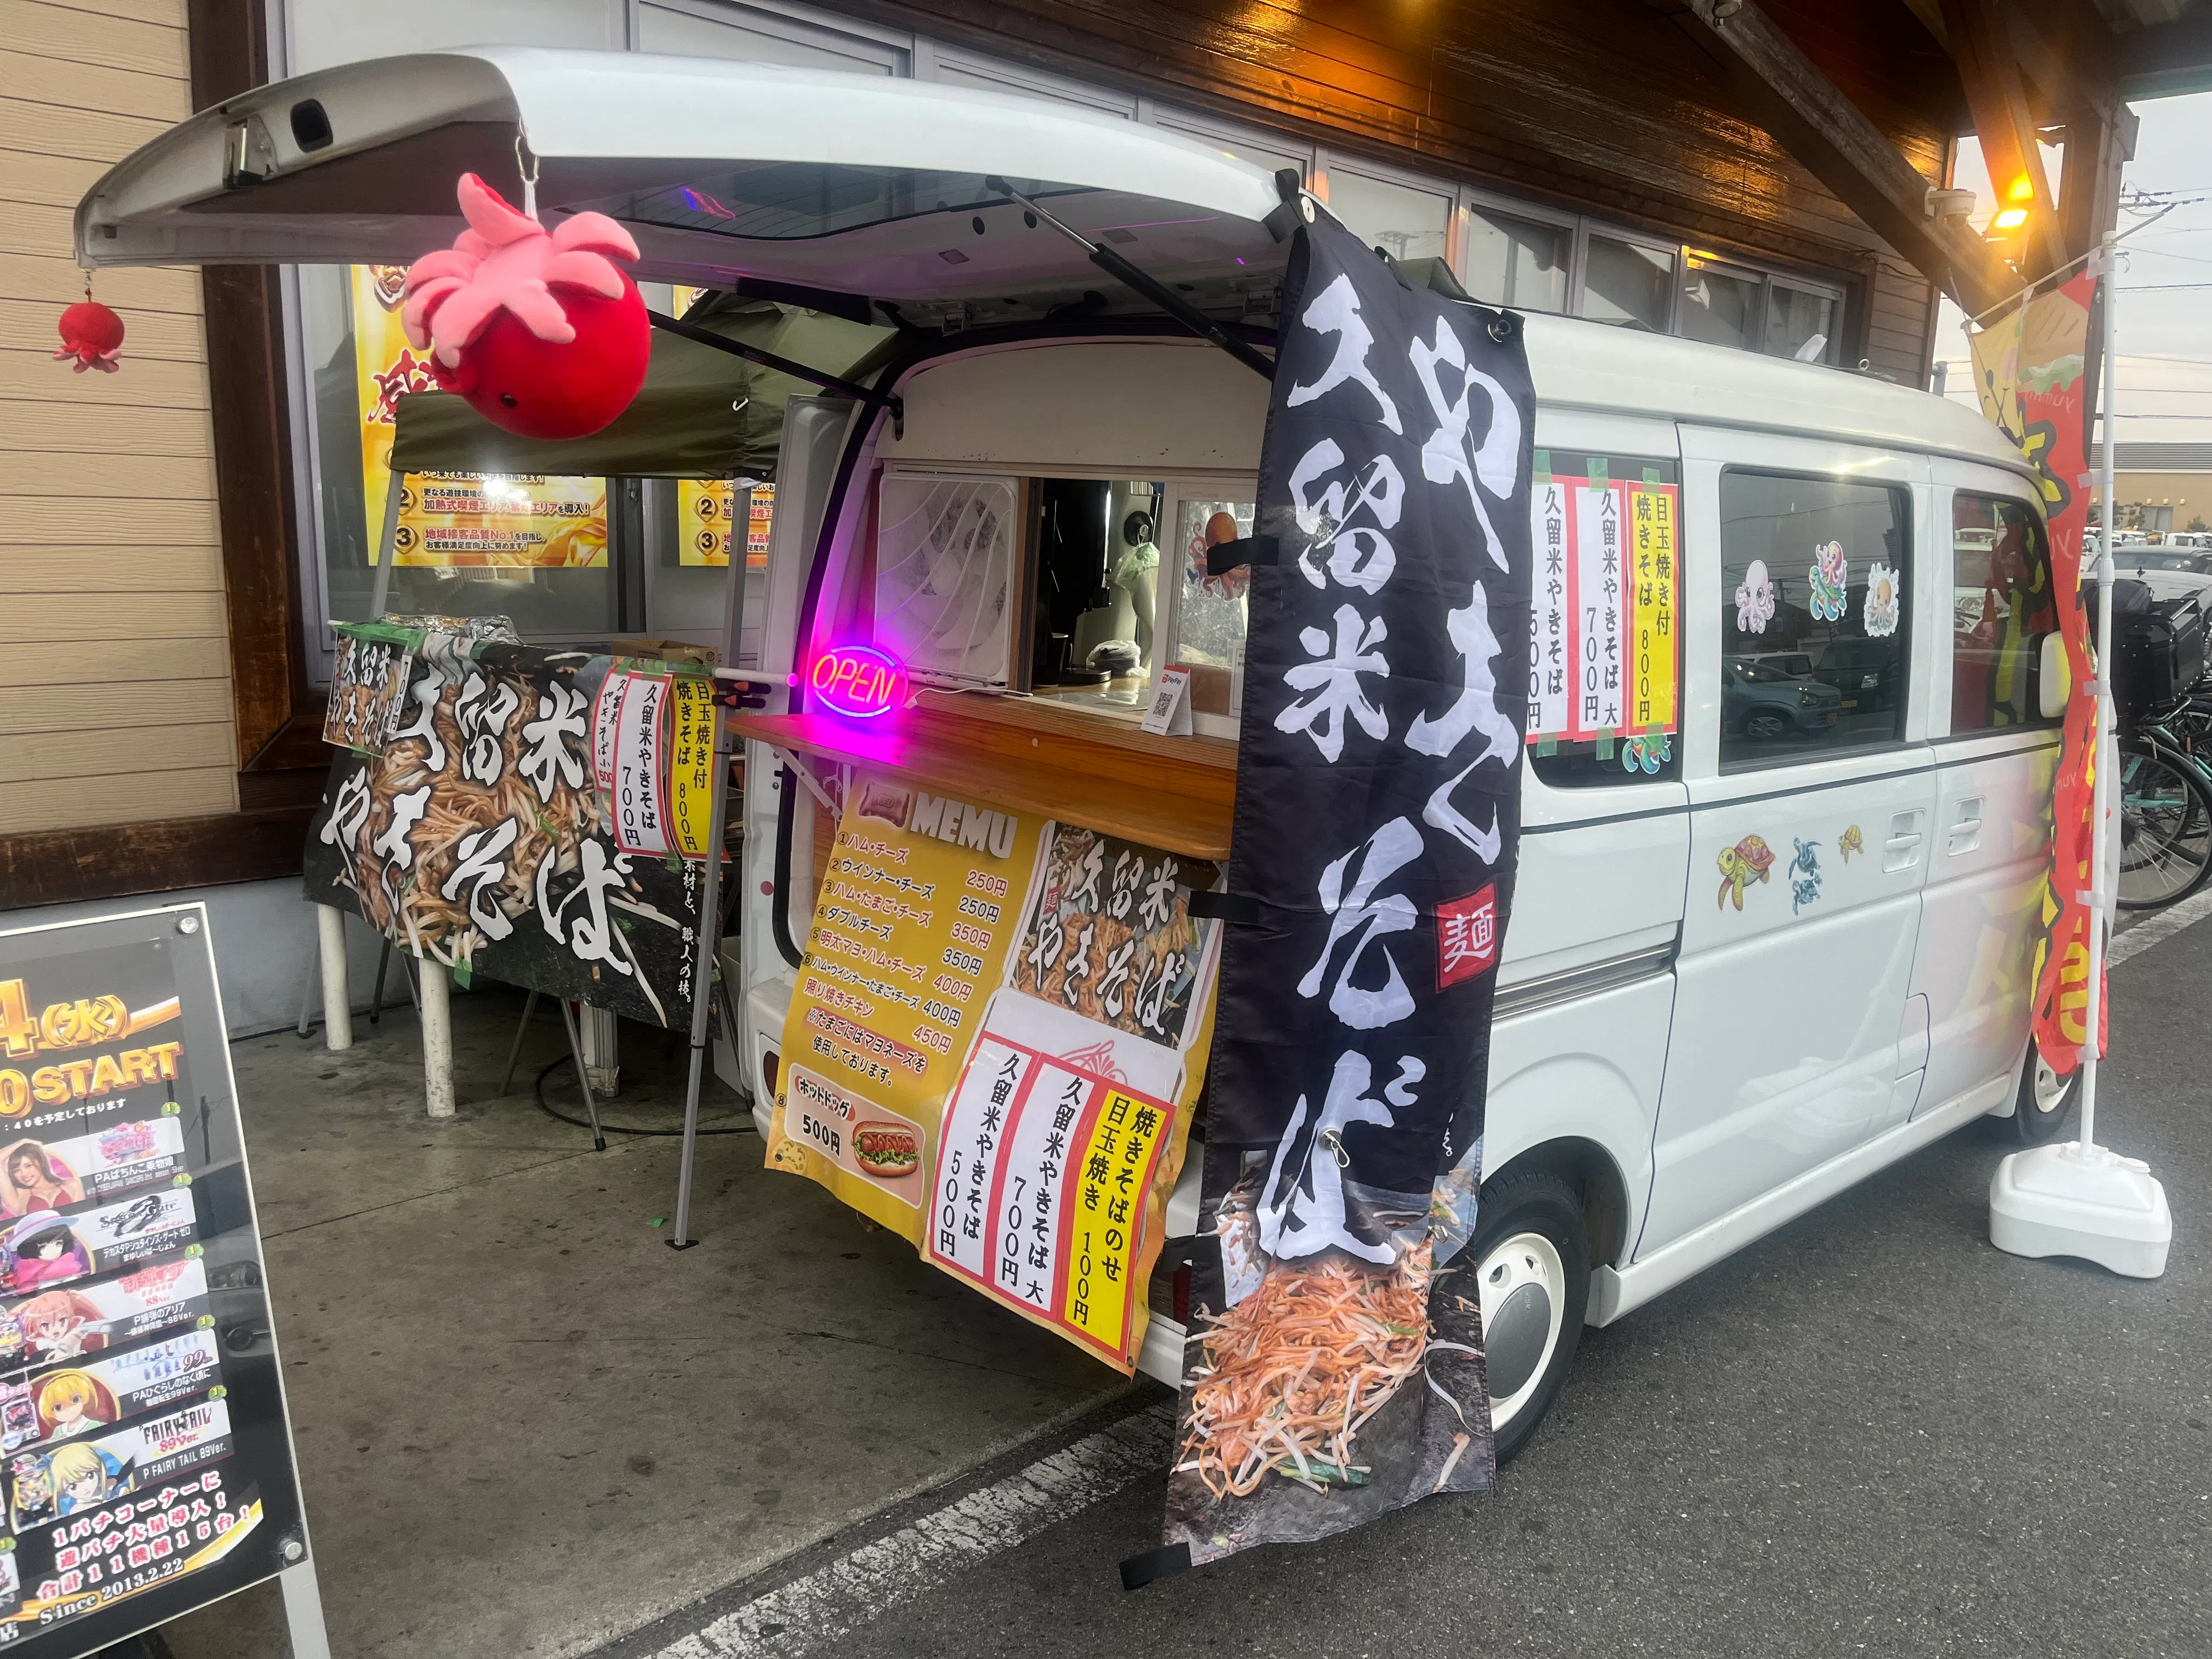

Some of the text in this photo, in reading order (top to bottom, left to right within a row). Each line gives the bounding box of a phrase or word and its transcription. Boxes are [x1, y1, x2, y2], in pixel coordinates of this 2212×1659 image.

[701, 499, 712, 516] 2
[396, 528, 410, 546] 3
[701, 532, 713, 549] 3
[1637, 494, 1653, 607] 焼きそば
[1655, 495, 1671, 637] 目玉焼き付
[1545, 486, 1564, 696] 久留米やきそば
[812, 653, 898, 706] OPEN
[1167, 675, 1183, 686] PayPay
[1585, 607, 1599, 723] 700円
[638, 684, 658, 830] 久留米やきそば
[693, 681, 712, 789] 目玉焼き付
[622, 766, 641, 846] 700円
[966, 868, 1009, 898] 250円
[958, 895, 1000, 923] 250円
[951, 922, 992, 950] 350円
[941, 948, 983, 975] 350円
[933, 974, 973, 1002] 400円
[922, 1000, 962, 1027] 400円
[912, 1024, 952, 1054] 450円
[31, 1041, 181, 1103] START
[799, 1078, 850, 1118] ホットドッグ
[802, 1114, 841, 1157] 500円
[962, 1053, 1020, 1240] 久留米やきそば
[940, 1150, 963, 1257] 500円
[1101, 1105, 1158, 1283] 焼きそばのせ
[1001, 1176, 1027, 1288] 700円
[143, 1442, 227, 1480] P FAIRY TAIL 89Ver.
[38, 1558, 185, 1626] Since 2013.2.22
